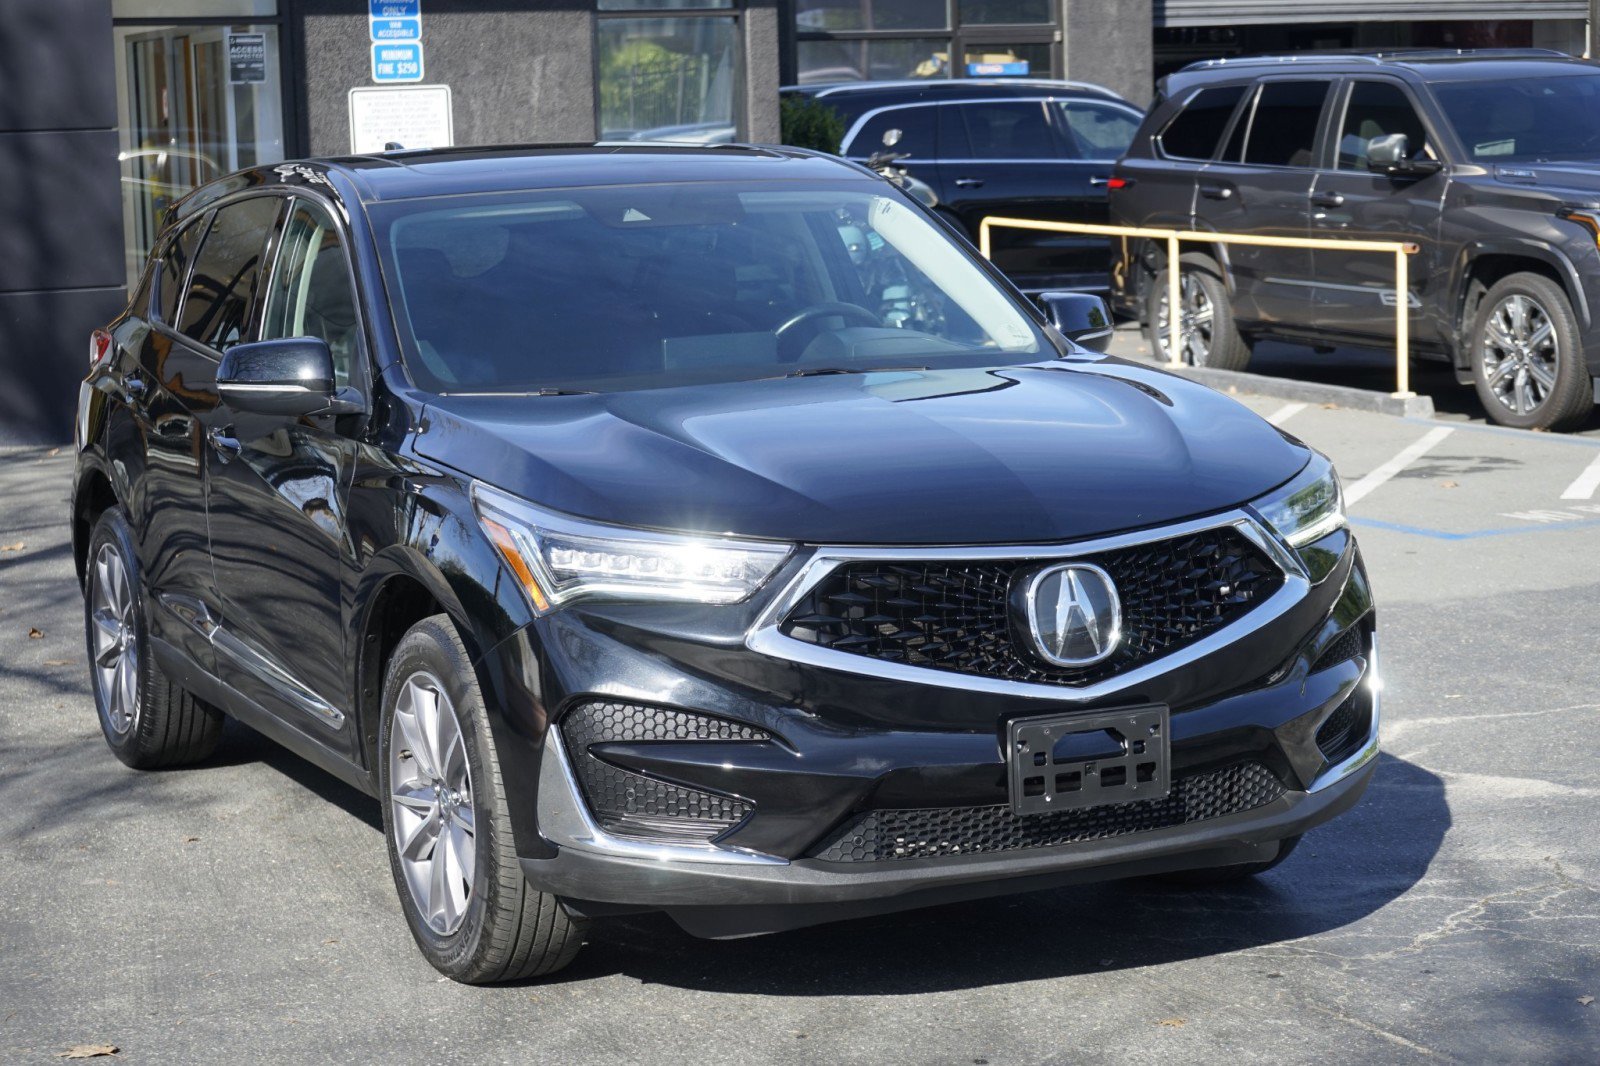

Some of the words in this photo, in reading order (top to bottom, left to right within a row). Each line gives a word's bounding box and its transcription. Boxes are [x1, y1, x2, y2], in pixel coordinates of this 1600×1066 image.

[382, 6, 407, 17] ONLY
[230, 46, 263, 54] ACCESS
[381, 49, 413, 61] MINIMUM
[378, 62, 394, 74] FINE
[397, 62, 418, 74] $250
